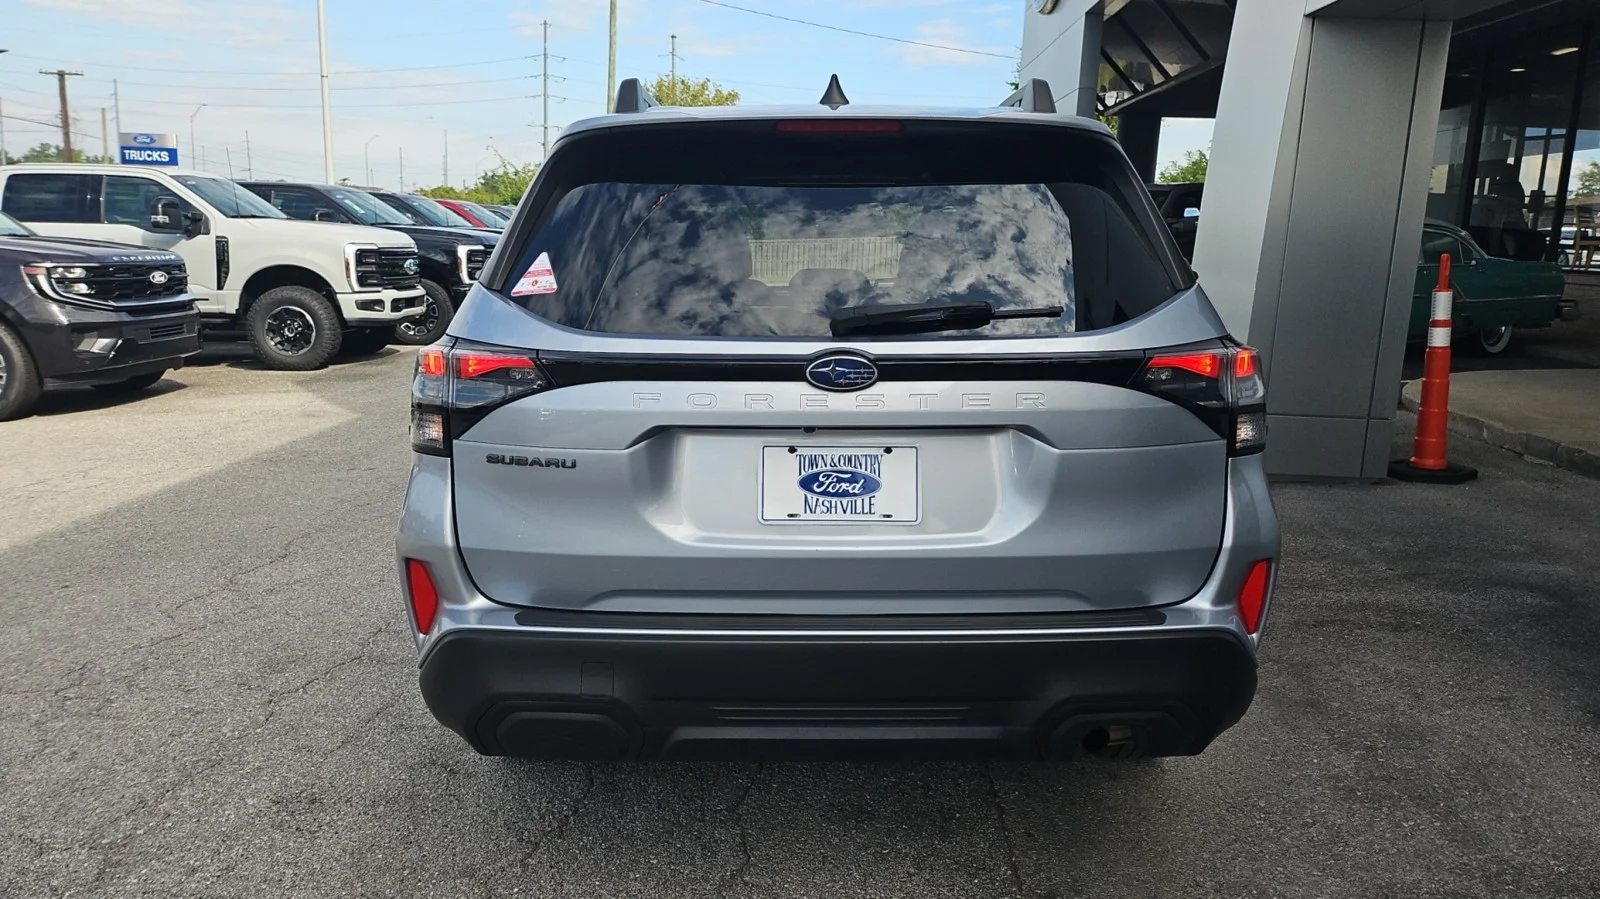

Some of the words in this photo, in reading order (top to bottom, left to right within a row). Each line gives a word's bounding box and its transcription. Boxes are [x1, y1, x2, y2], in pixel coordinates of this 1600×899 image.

[123, 150, 170, 162] TRUCKS
[632, 392, 1047, 410] FORESTER
[485, 453, 577, 469] SUBARU
[796, 453, 828, 476] TOWN
[838, 453, 883, 479] COUNTRY
[812, 471, 865, 494] Ford
[803, 494, 876, 515] NASHVILLE
